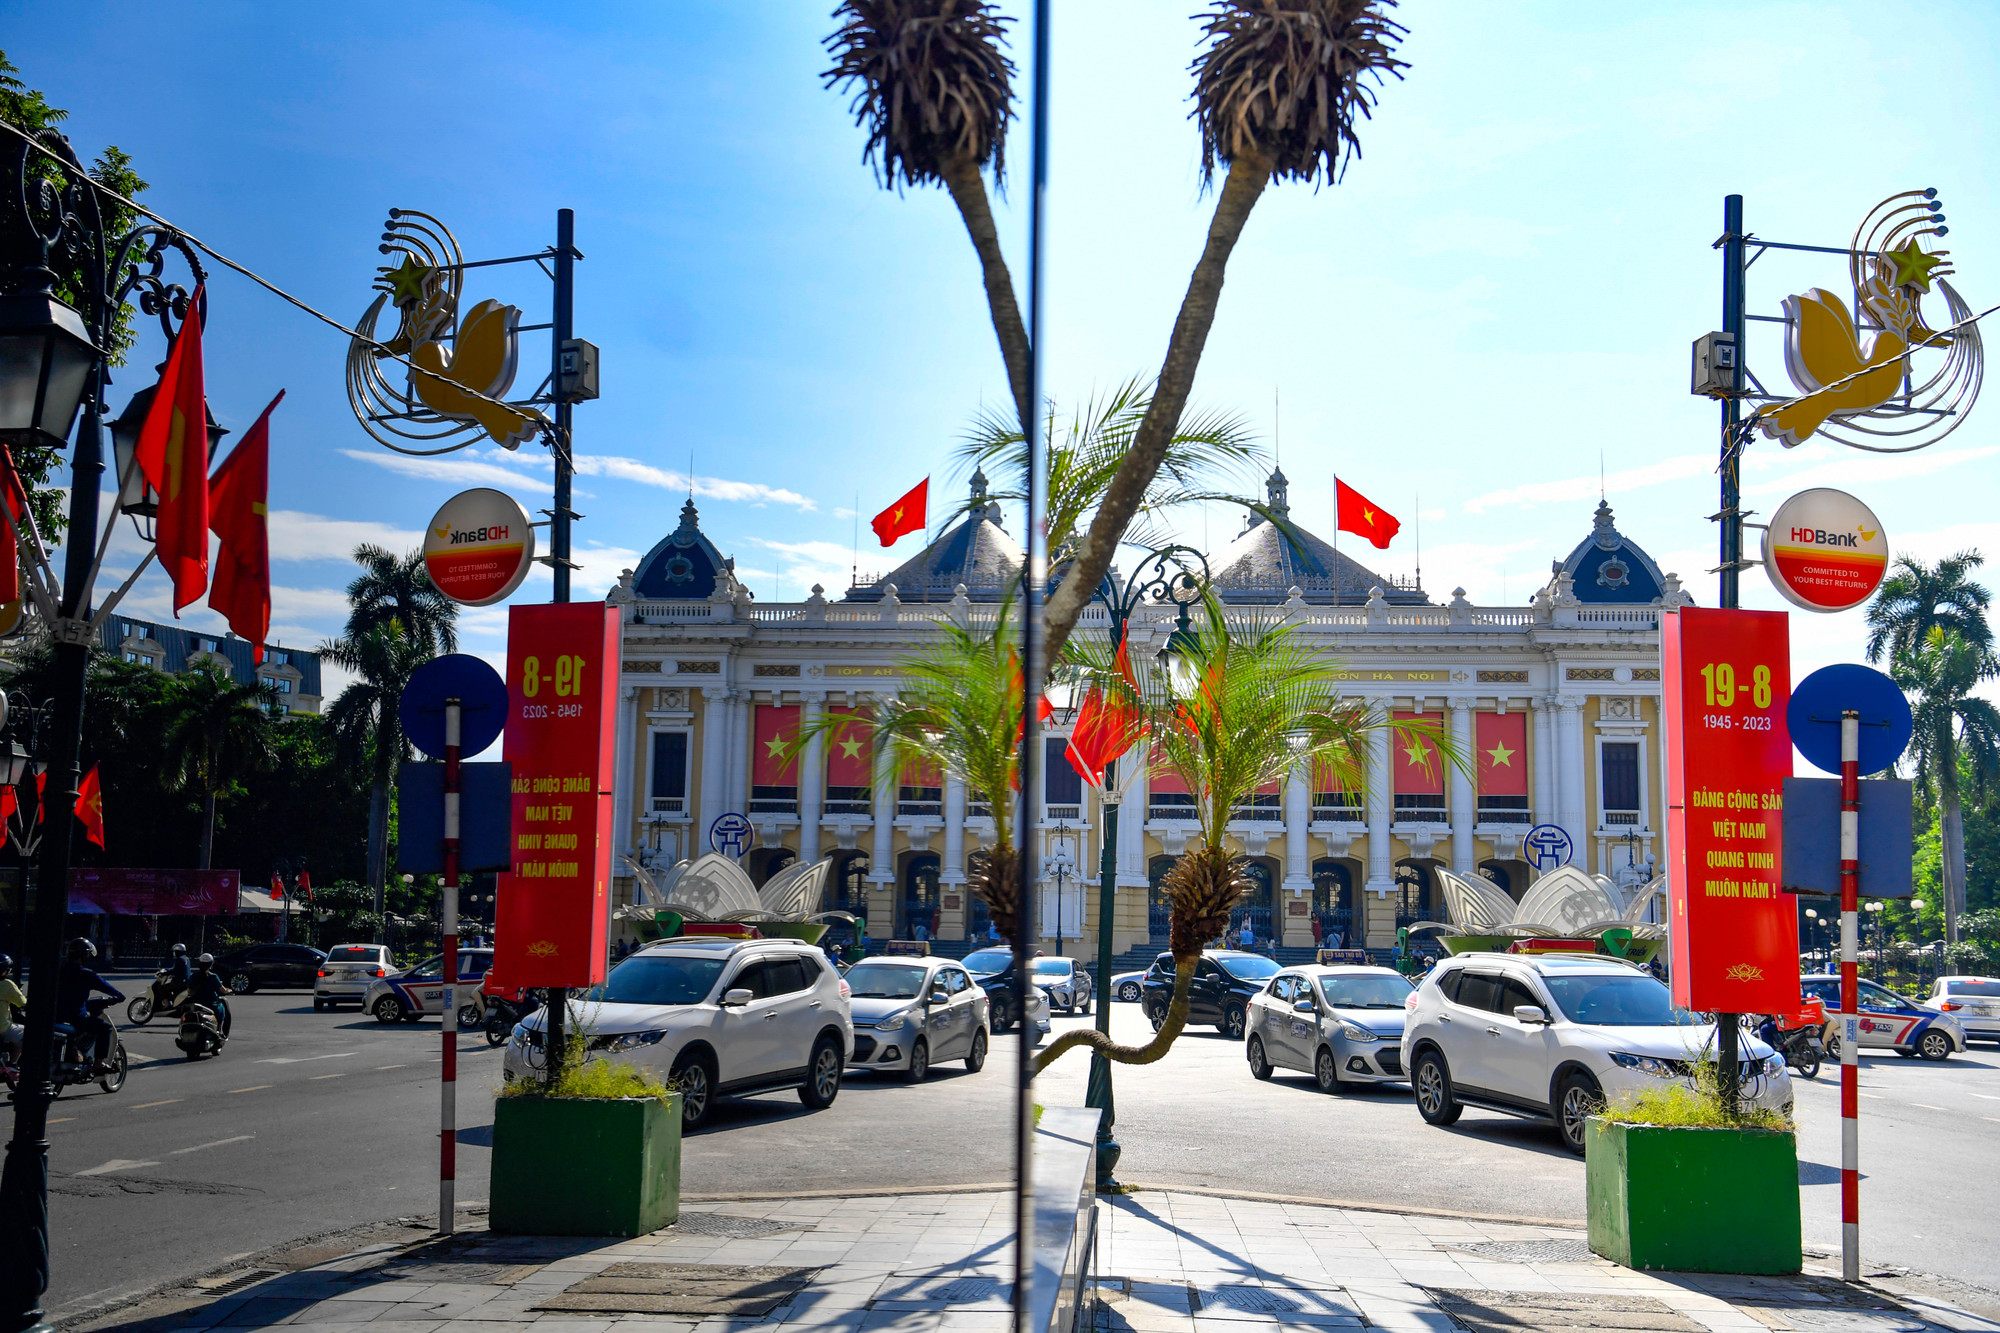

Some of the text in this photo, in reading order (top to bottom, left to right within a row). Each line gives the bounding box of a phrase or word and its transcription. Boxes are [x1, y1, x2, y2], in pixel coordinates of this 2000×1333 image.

[1791, 527, 1858, 547] HDBank
[1803, 566, 1859, 578] COMMITTED TO
[1794, 576, 1868, 589] YOUR BEST RETURNS
[1372, 671, 1394, 680] HÀ
[1408, 672, 1434, 681] NỘI
[1703, 714, 1732, 729] 1945
[1743, 716, 1771, 730] 2023
[1693, 786, 1724, 808] ĐẢNG
[1727, 789, 1758, 812] CỘNG
[1713, 818, 1766, 841] VIỆT NAM
[1707, 850, 1774, 869] QUANG VINH
[1706, 878, 1739, 897] MUÔN
[1743, 879, 1769, 898] NĂM
[1874, 1024, 1893, 1032] TAXI
